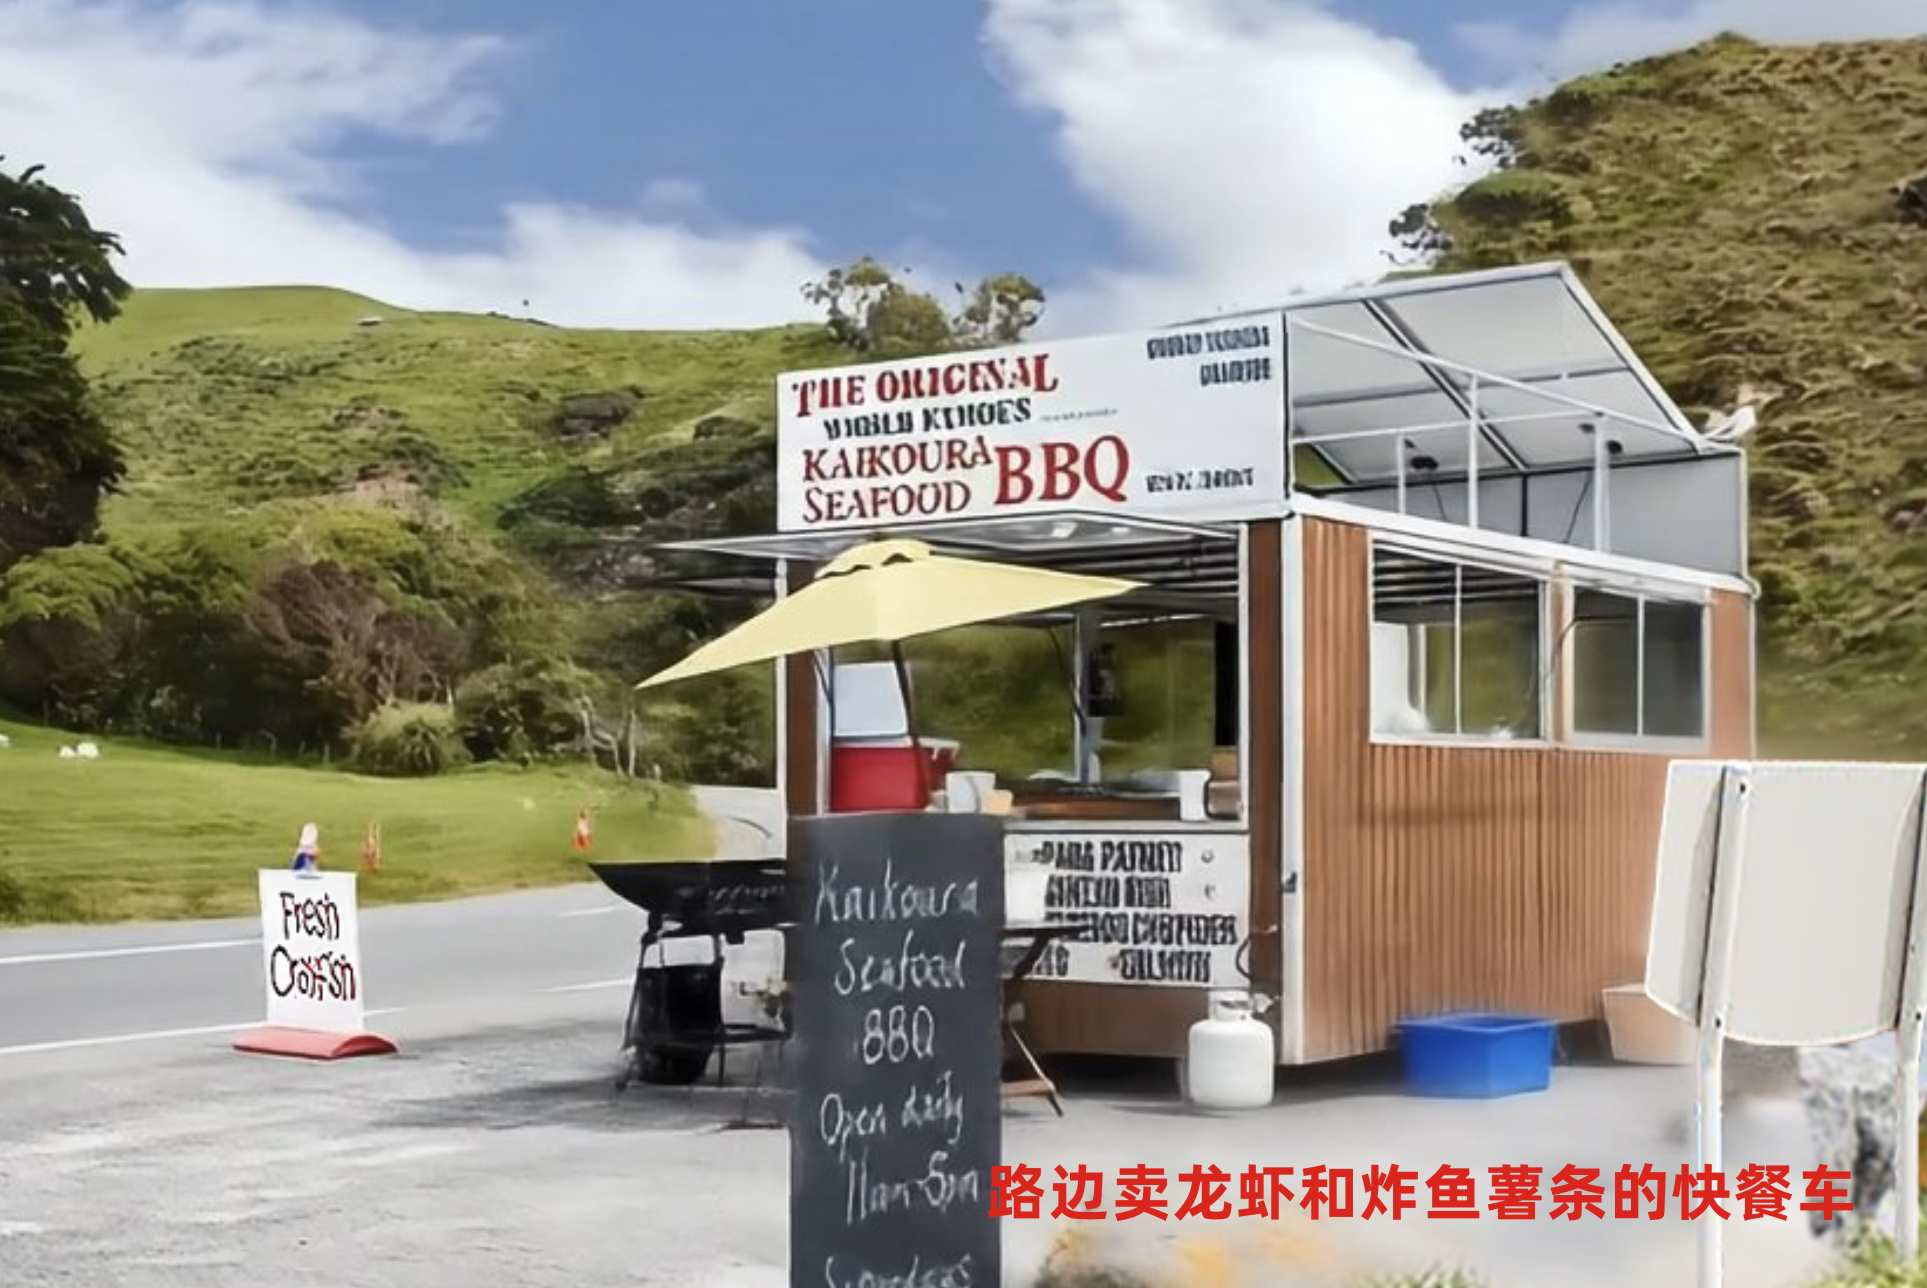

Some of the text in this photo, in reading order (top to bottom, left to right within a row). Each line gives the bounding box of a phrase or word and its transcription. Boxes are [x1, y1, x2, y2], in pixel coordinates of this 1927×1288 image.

[791, 375, 866, 418] THE
[803, 435, 992, 482] KAIKOURA
[994, 435, 1130, 505] BBQ
[803, 480, 971, 523] SEAFOOD
[279, 891, 341, 940] Fresh
[863, 1005, 935, 1065] BBQ
[820, 1093, 887, 1163] Open
